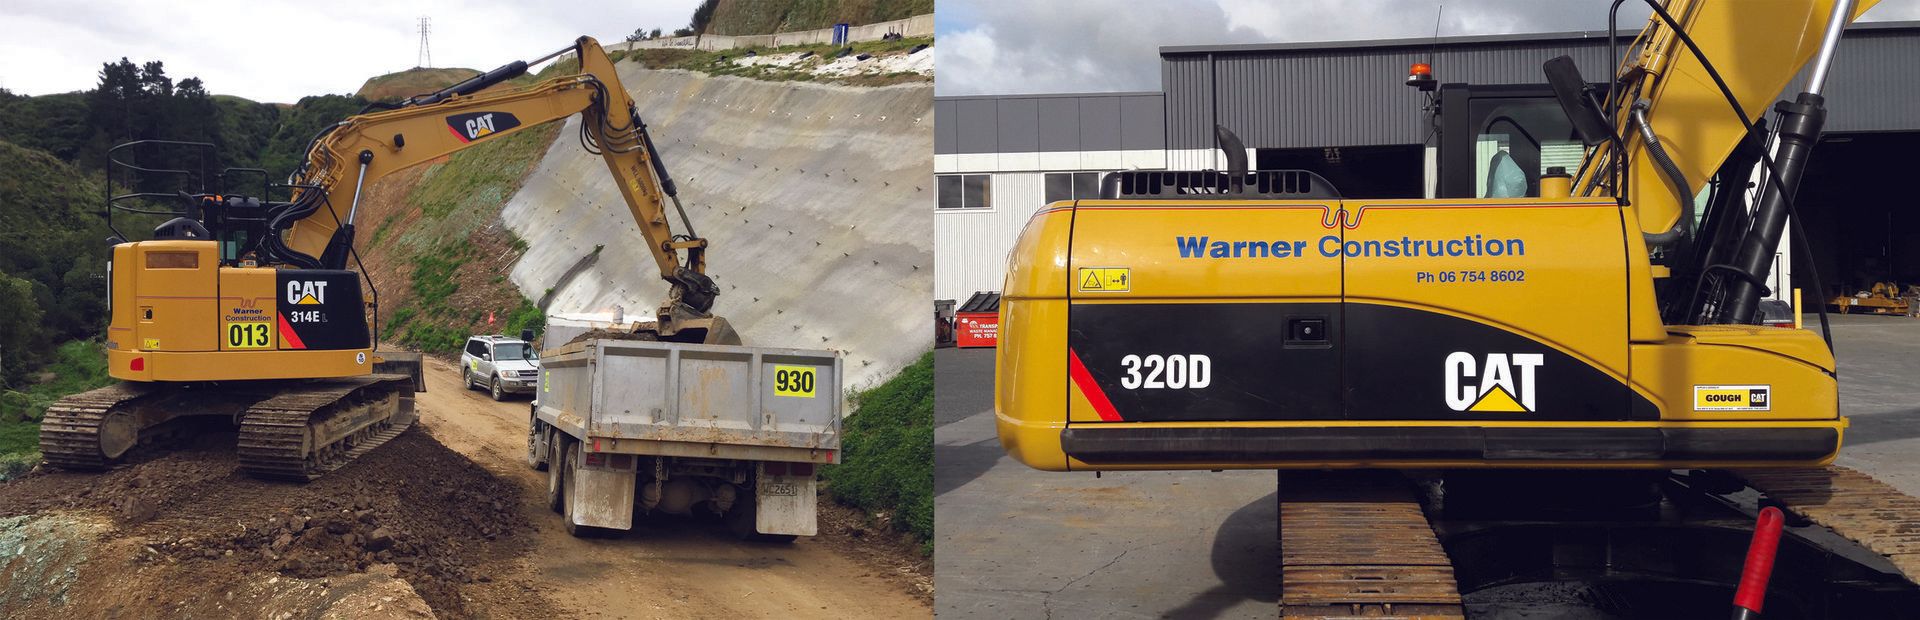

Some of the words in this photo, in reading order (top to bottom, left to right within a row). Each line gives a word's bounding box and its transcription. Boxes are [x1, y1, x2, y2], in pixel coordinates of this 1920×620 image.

[465, 113, 496, 139] CAT
[1176, 236, 1307, 258] Warner
[1318, 234, 1525, 259] Construction
[1416, 271, 1435, 284] Ph
[1438, 271, 1456, 283] 06
[1460, 271, 1486, 283] 754
[1490, 270, 1525, 283] 8602
[287, 280, 328, 305] CAT
[225, 314, 272, 322] Construction
[291, 310, 320, 323] 314E
[229, 324, 269, 347] 013
[776, 369, 815, 394] 930
[1120, 353, 1212, 390] 320D
[1444, 351, 1545, 412] CAT
[1705, 394, 1742, 402] GOUGH
[1751, 393, 1766, 403] CAT
